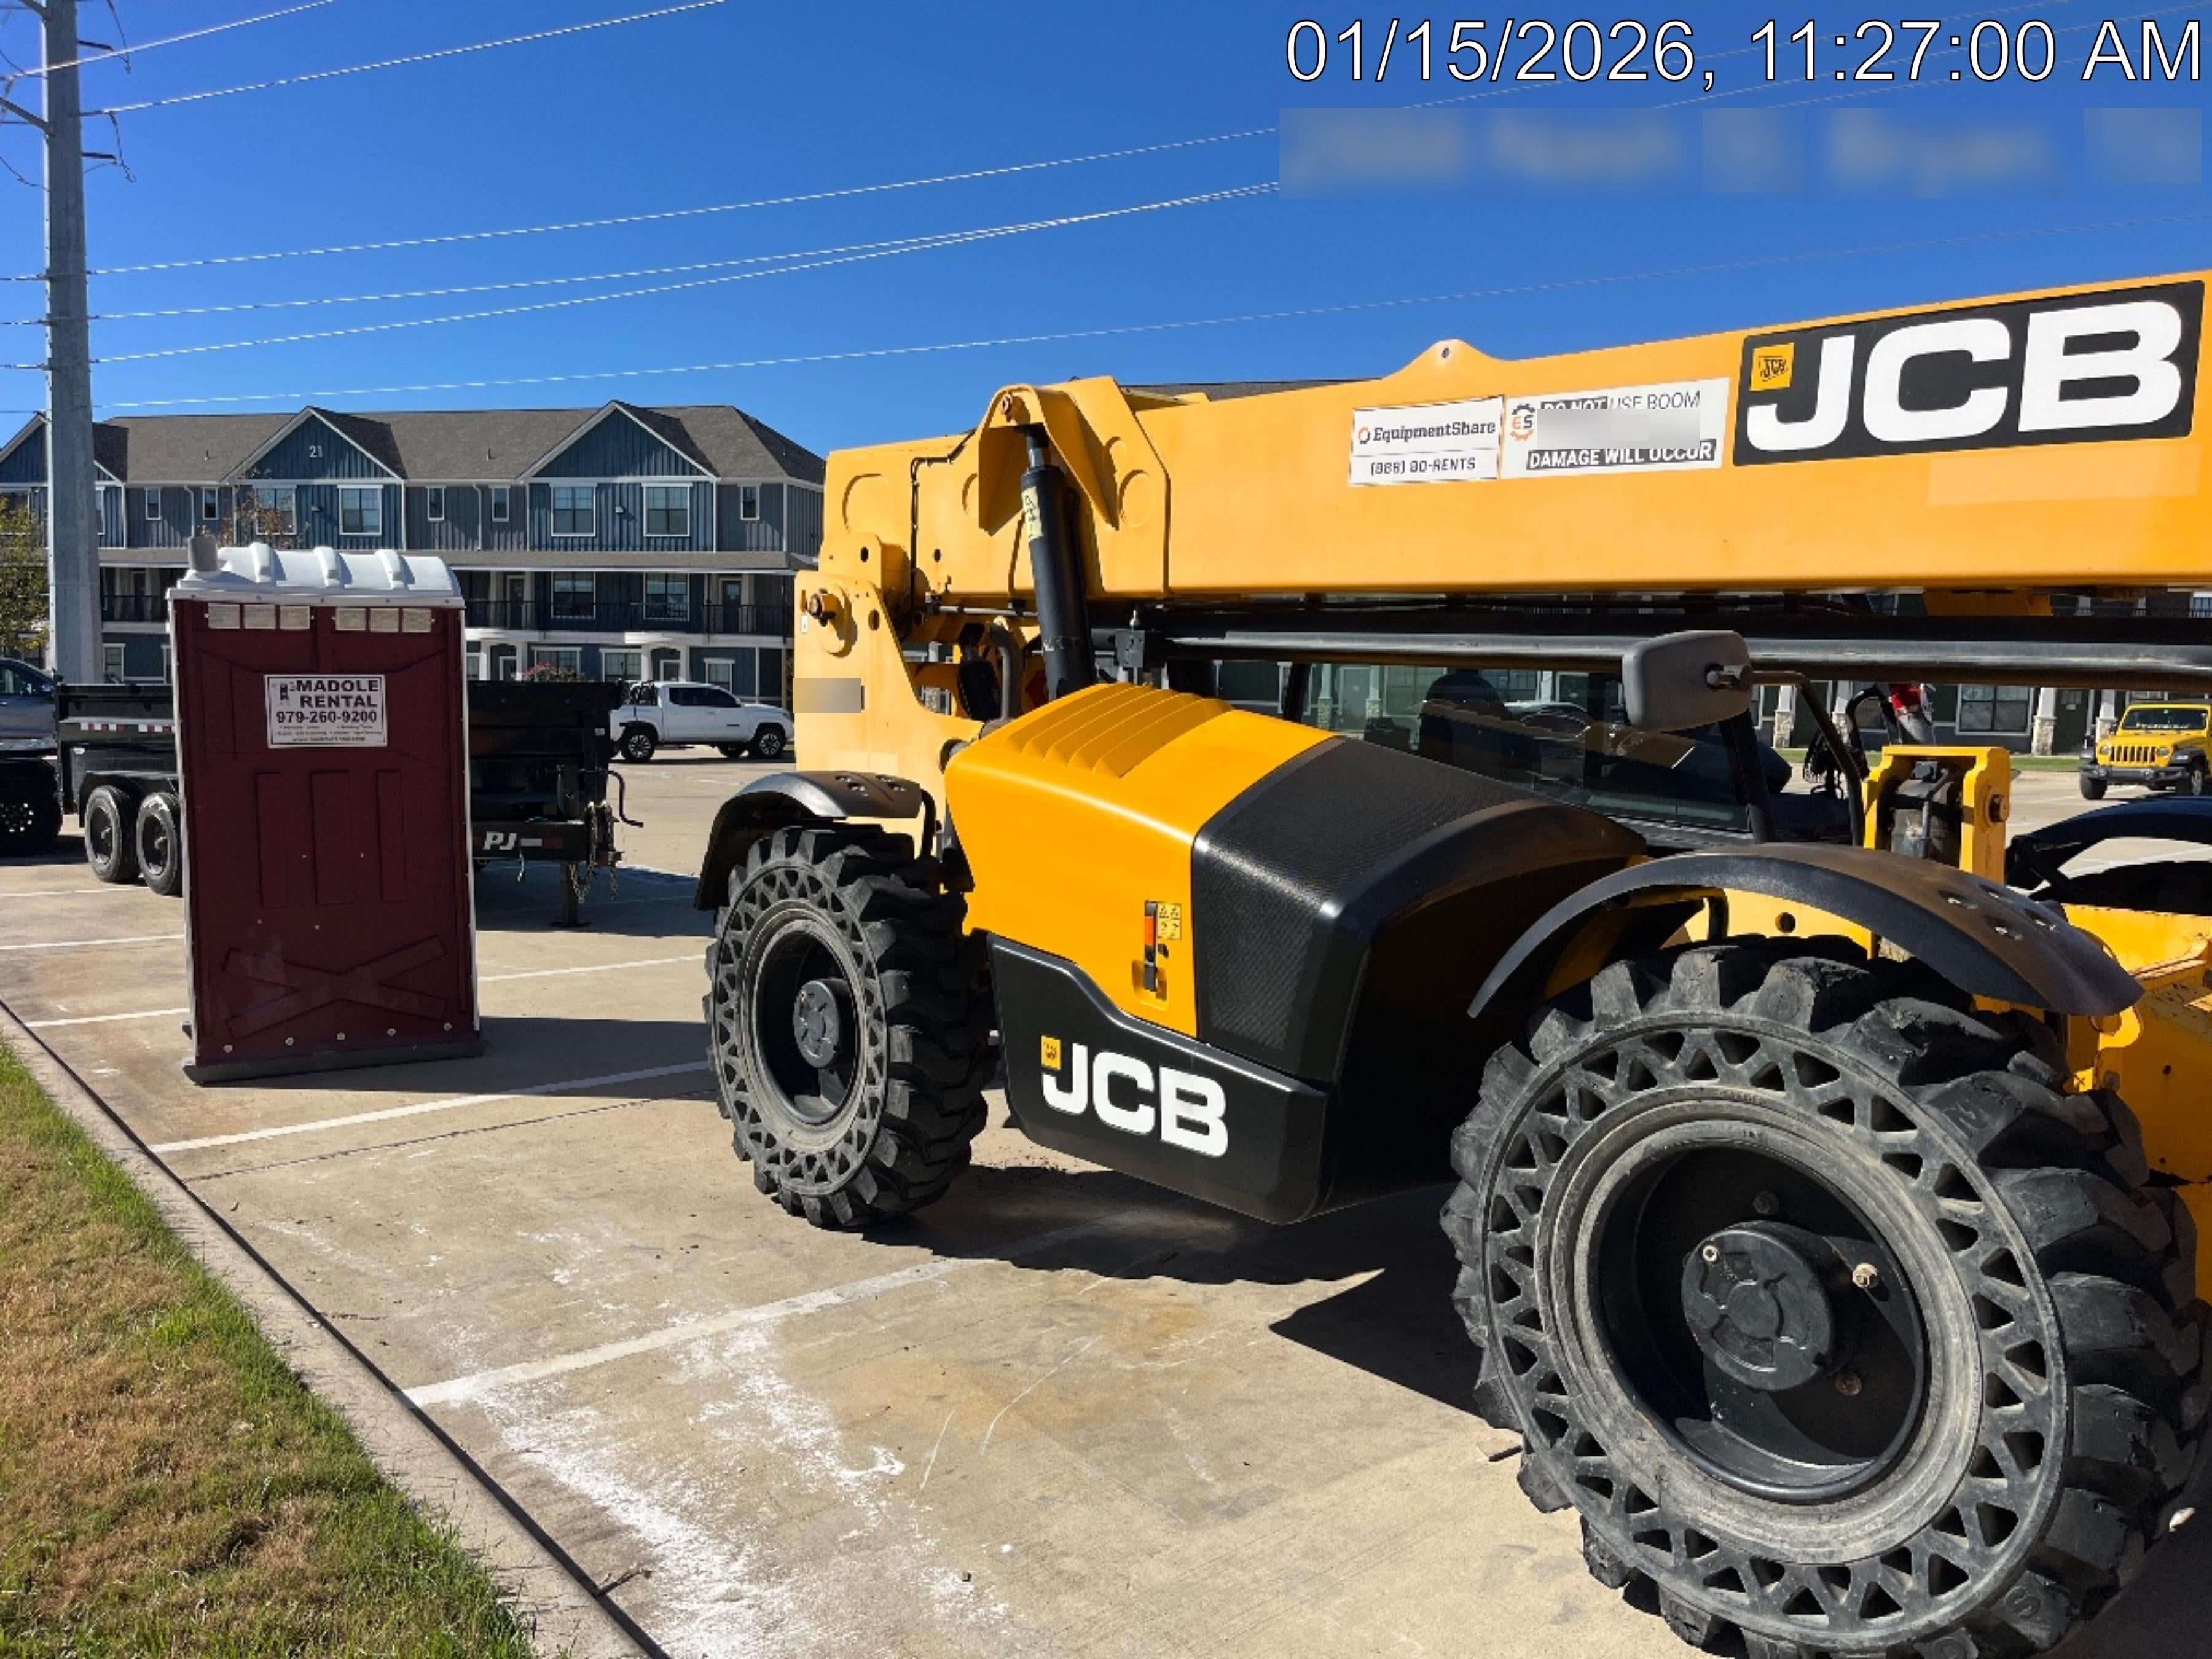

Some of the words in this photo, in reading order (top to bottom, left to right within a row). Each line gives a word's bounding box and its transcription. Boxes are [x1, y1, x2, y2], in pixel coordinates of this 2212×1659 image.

[1747, 300, 2182, 452] JCB
[1647, 390, 1700, 409] BOOM
[1373, 421, 1496, 443] EquipmentShare
[309, 445, 323, 458] 21
[1529, 449, 1601, 469] DAMAGE
[1604, 448, 1645, 464] WILL
[1649, 442, 1712, 461] OCCUR
[296, 680, 379, 692] MADOLE
[300, 695, 378, 707] RENTAL
[276, 710, 377, 723] 979-260-9200
[483, 831, 517, 851] PJ
[1042, 1042, 1228, 1158] JCB
